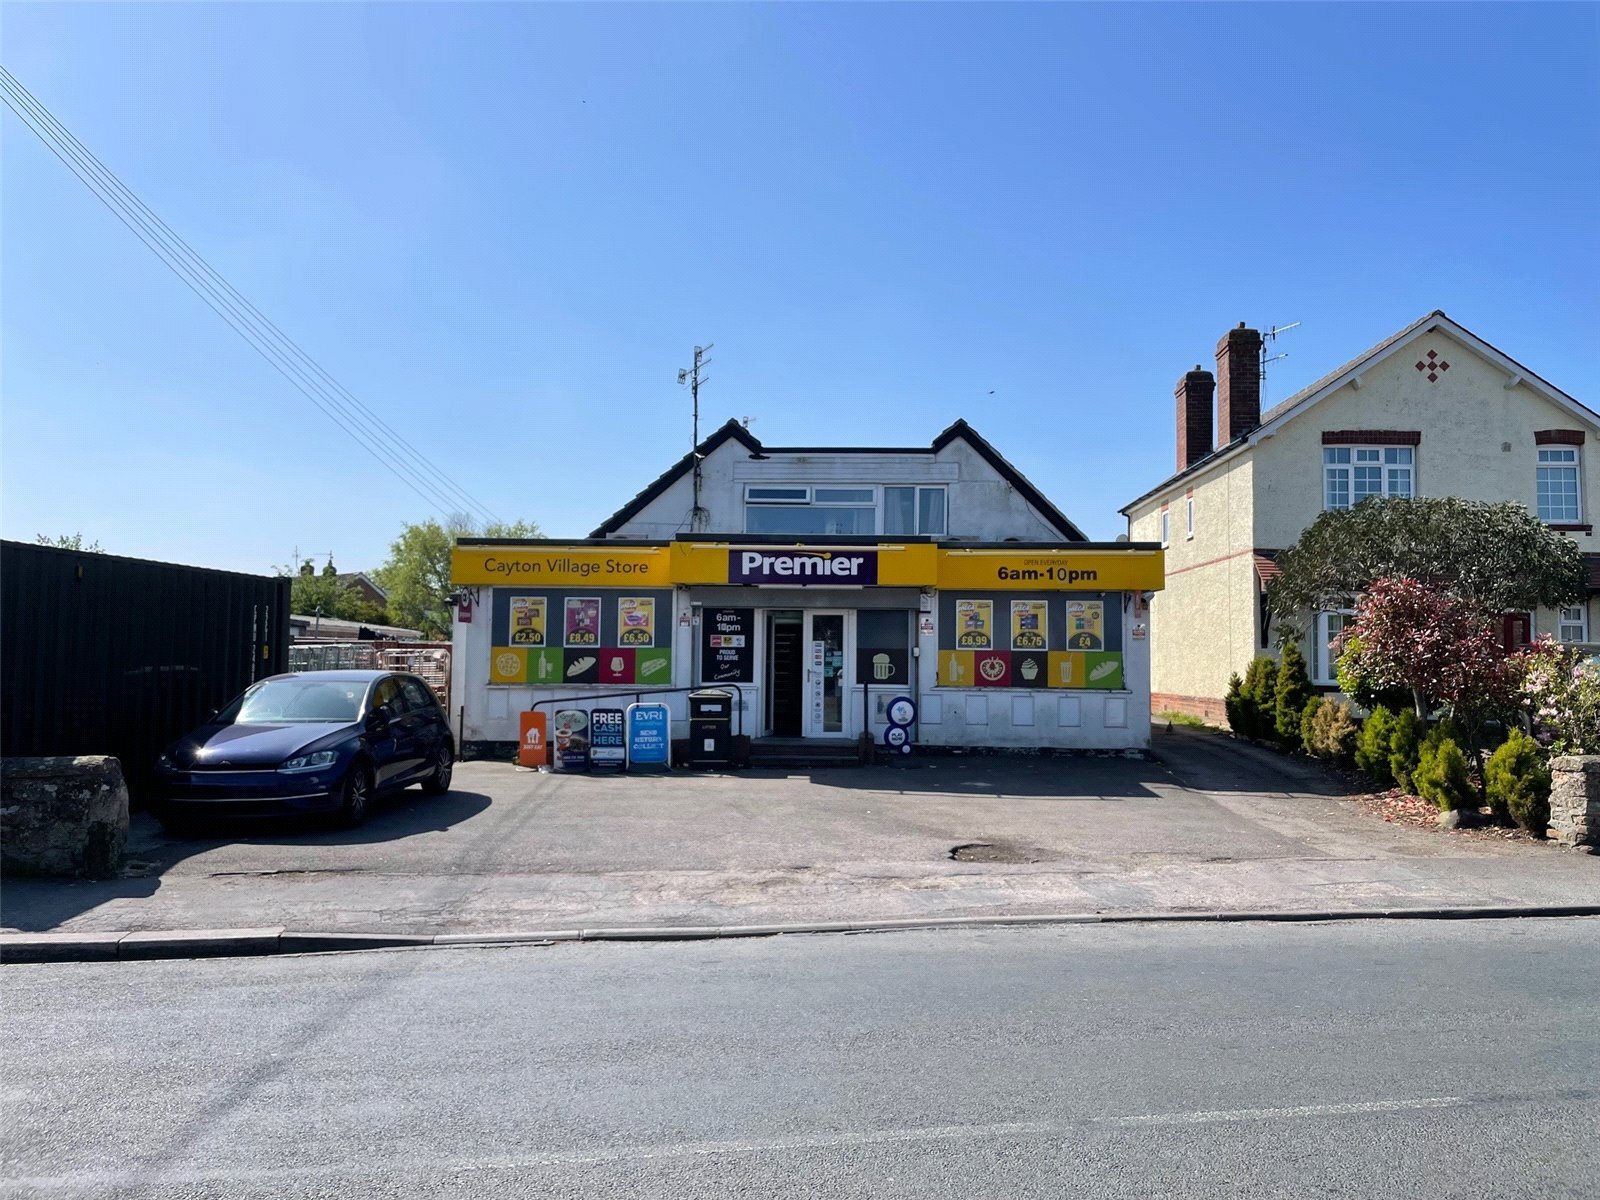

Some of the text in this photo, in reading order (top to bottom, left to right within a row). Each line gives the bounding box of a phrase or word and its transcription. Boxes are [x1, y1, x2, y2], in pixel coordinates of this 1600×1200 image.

[484, 558, 649, 577] Cayton Village Store
[741, 551, 864, 576] Premier
[998, 566, 1098, 584] 6am-10pm
[515, 632, 541, 643] £2.50
[569, 632, 595, 643] £8.49
[623, 633, 649, 643] £6.50
[961, 635, 988, 646] £8.99
[1078, 637, 1091, 647] £4
[592, 712, 622, 724] FREE
[593, 724, 622, 732] CASH
[593, 736, 622, 745] HERE
